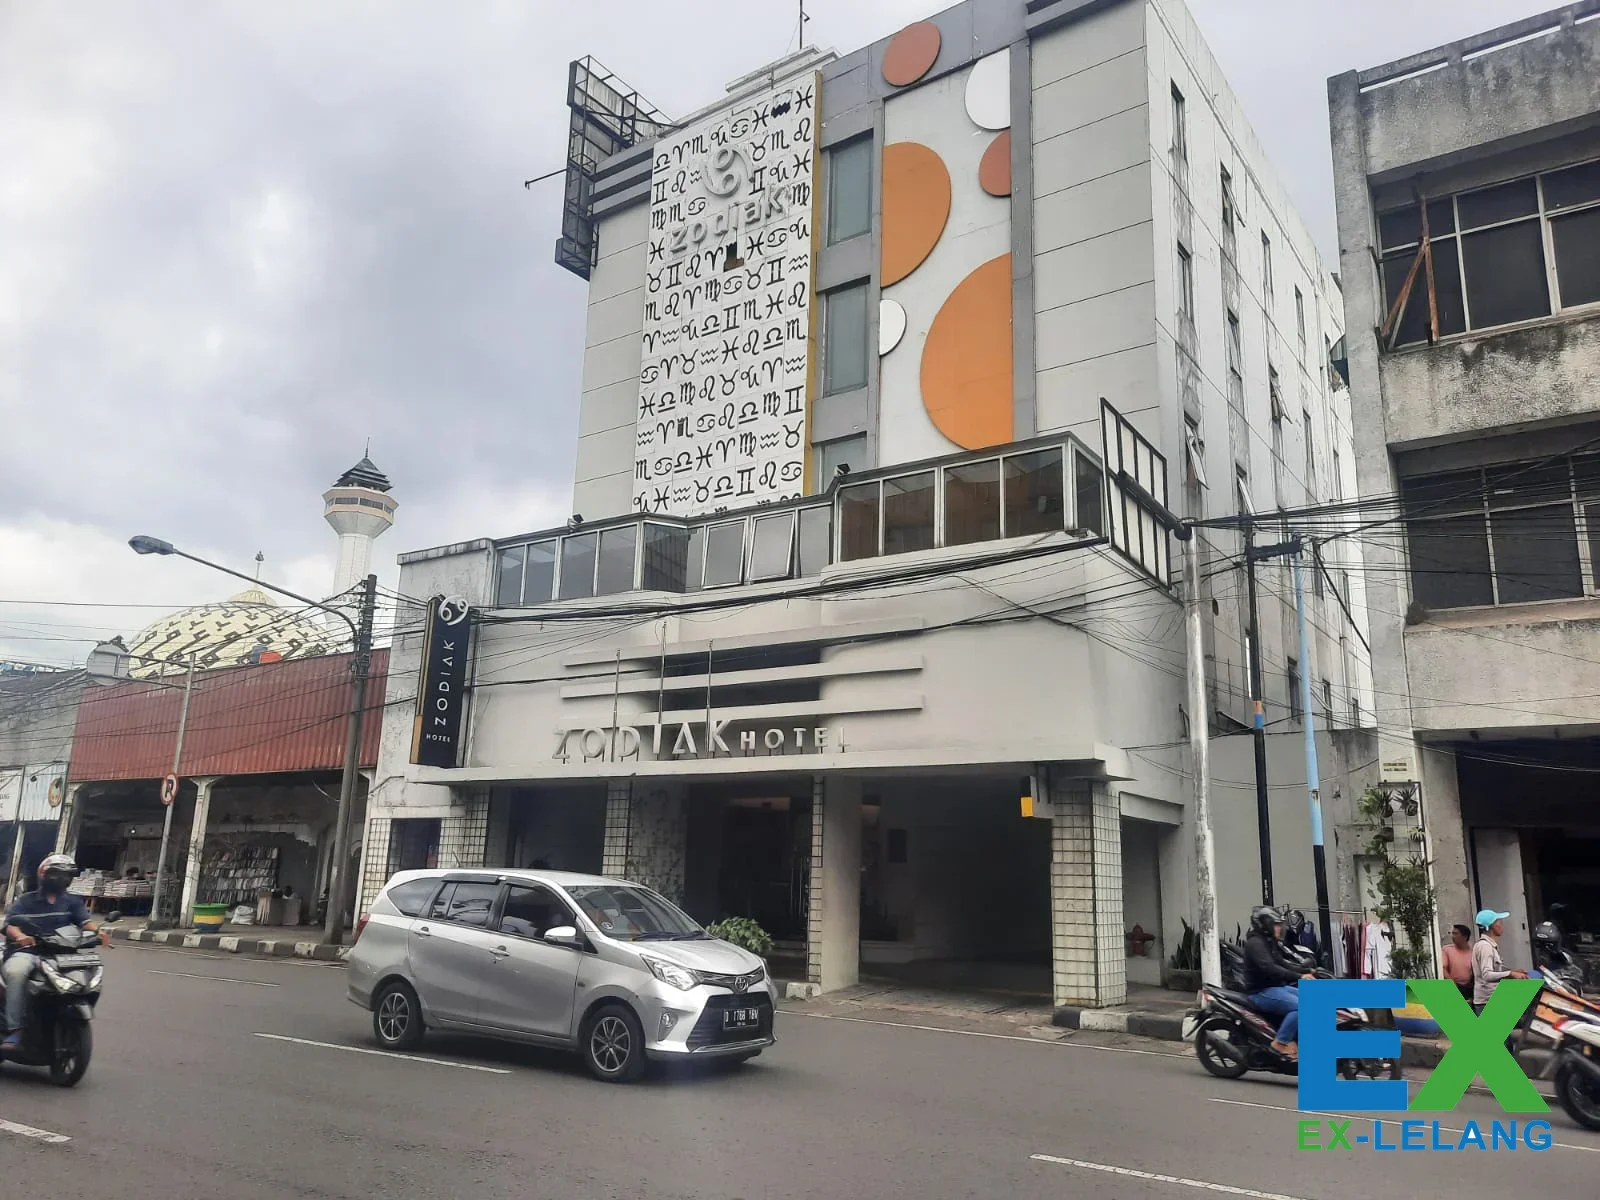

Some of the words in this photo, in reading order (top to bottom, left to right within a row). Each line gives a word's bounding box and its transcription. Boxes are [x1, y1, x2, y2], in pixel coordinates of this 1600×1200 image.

[434, 639, 455, 726] ZODIAK
[426, 733, 451, 743] HOTEL
[552, 719, 732, 760] ZODIAK
[740, 727, 851, 750] HOTEL
